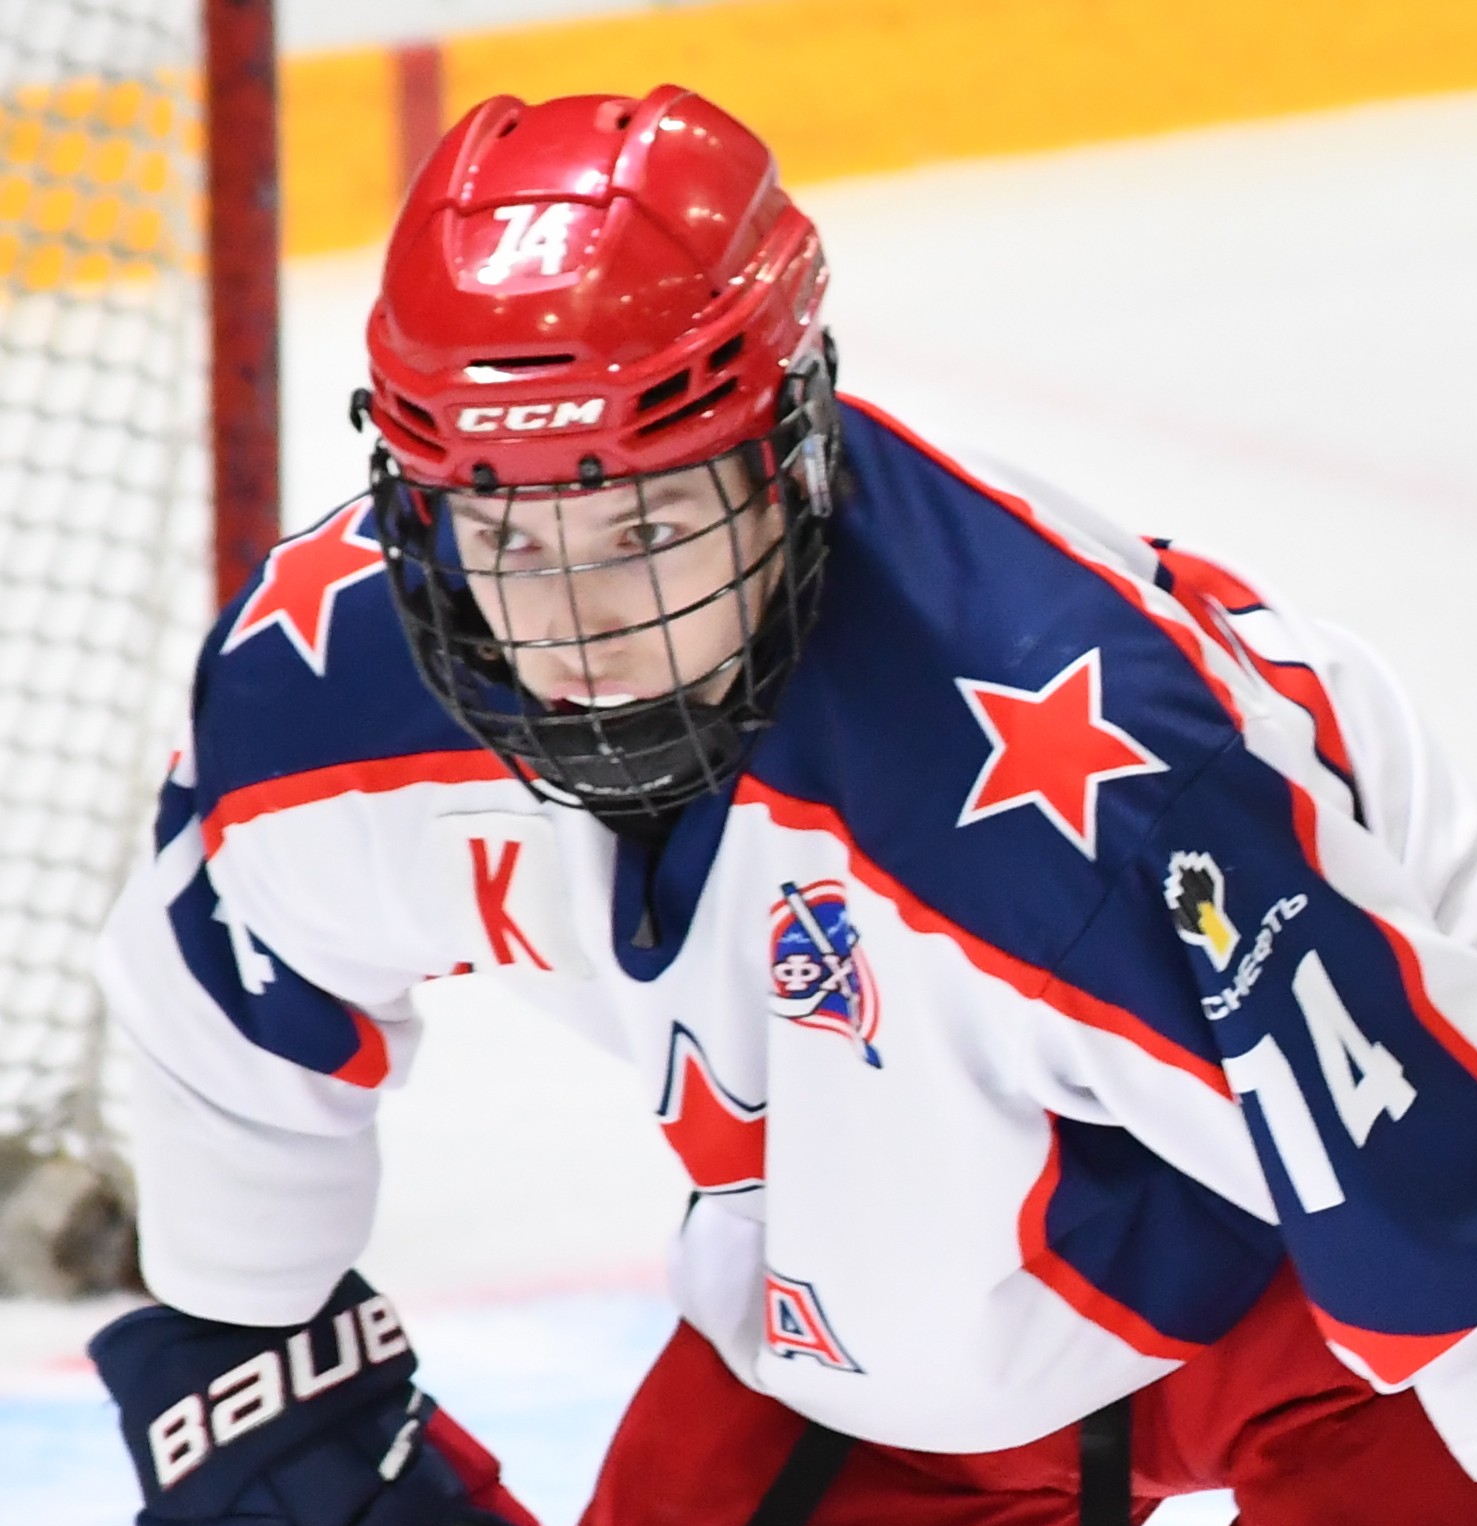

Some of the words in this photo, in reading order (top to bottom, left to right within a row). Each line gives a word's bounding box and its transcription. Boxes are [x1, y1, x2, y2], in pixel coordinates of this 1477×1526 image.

[484, 202, 574, 276] 74
[456, 398, 605, 433] CCM
[1200, 893, 1308, 1021] СНЕФТЬ
[1222, 949, 1418, 1214] 74
[148, 1294, 410, 1489] BAUE
